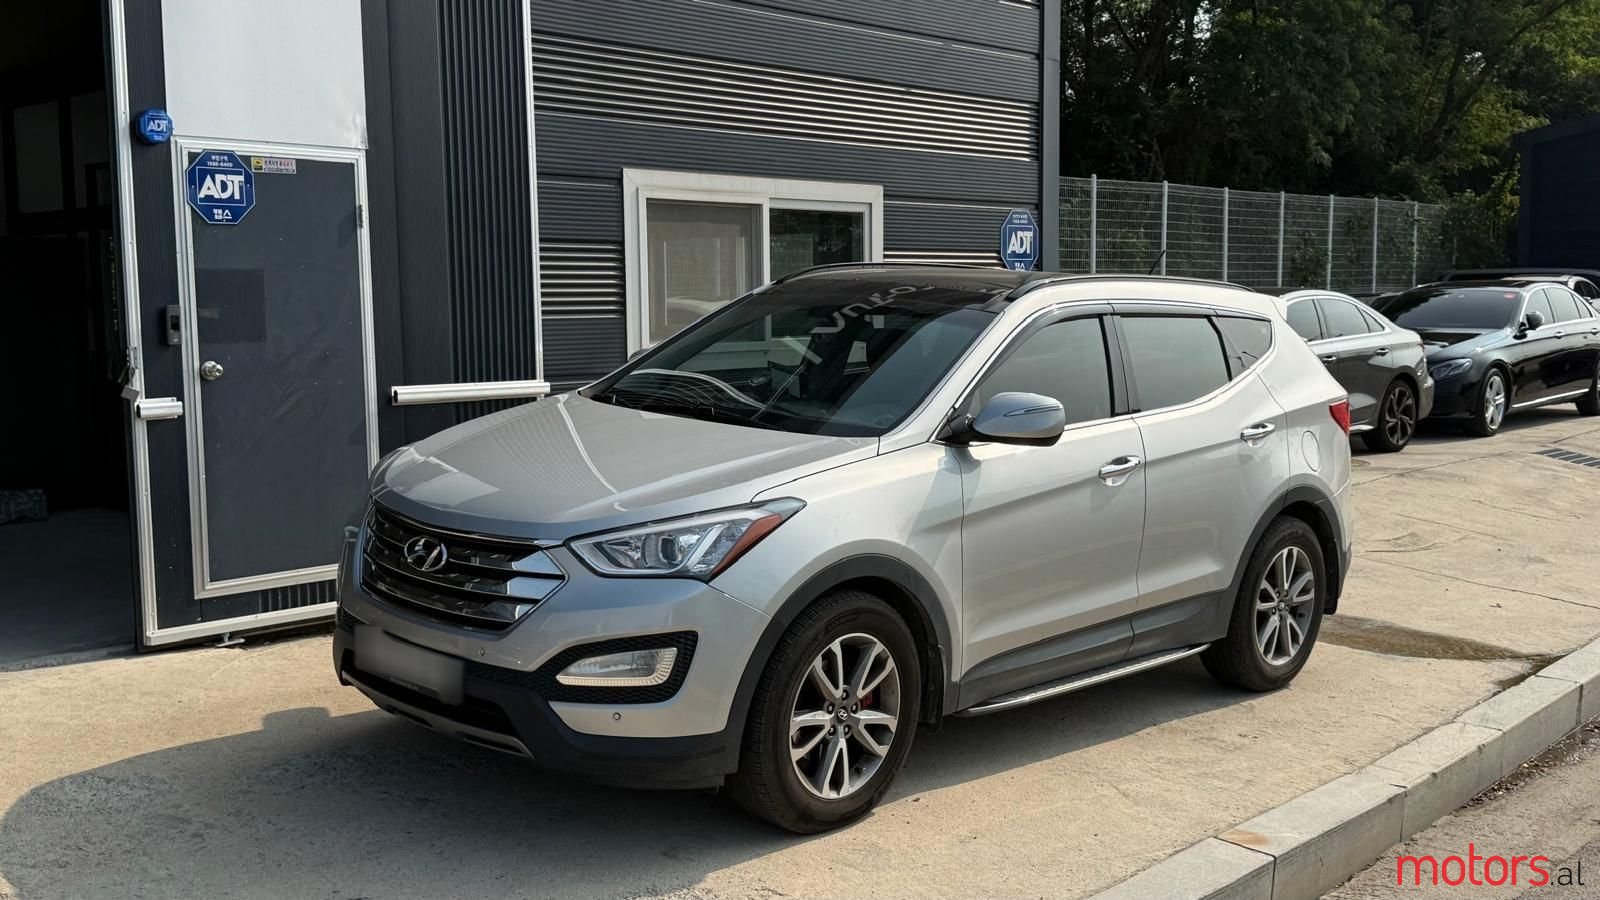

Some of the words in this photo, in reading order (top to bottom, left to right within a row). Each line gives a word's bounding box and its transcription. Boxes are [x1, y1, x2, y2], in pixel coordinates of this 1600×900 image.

[147, 119, 168, 132] ADT
[198, 174, 244, 200] ADT
[1007, 230, 1033, 254] ADT
